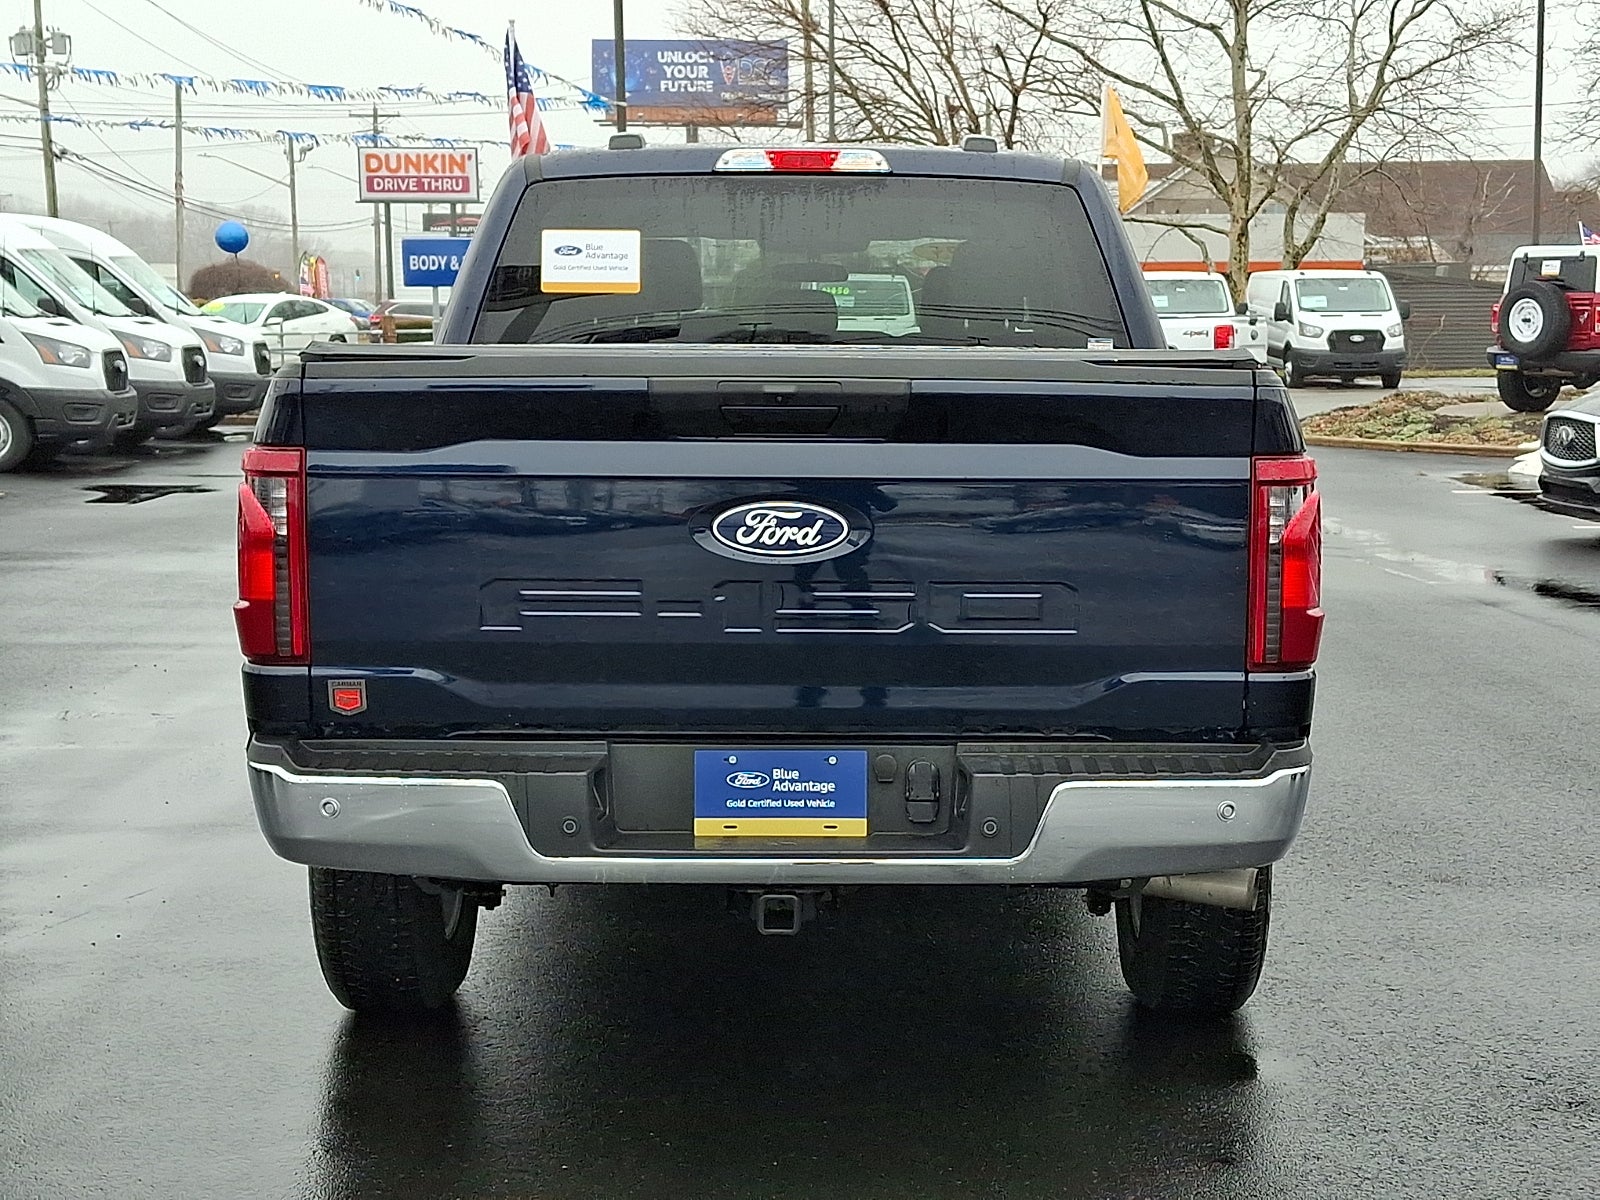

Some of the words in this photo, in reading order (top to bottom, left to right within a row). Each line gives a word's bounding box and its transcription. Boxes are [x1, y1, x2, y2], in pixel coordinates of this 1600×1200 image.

[657, 50, 715, 63] UNLOCK
[662, 65, 710, 79] YOUR
[660, 80, 714, 92] FUTURE
[364, 153, 473, 174] DUNKIN'
[373, 178, 418, 191] DRIVE
[421, 178, 463, 191] THRU
[585, 243, 604, 251] Blue
[409, 255, 448, 271] BODY
[450, 255, 460, 270] &
[585, 252, 629, 261] Advantage
[735, 509, 825, 546] Ford
[733, 774, 763, 786] Ford
[772, 768, 800, 780] Blue
[772, 780, 836, 794] Advantage
[726, 799, 746, 808] Gold
[747, 799, 782, 808] Certified
[784, 799, 805, 808] Used
[807, 799, 836, 808] Vehicle
